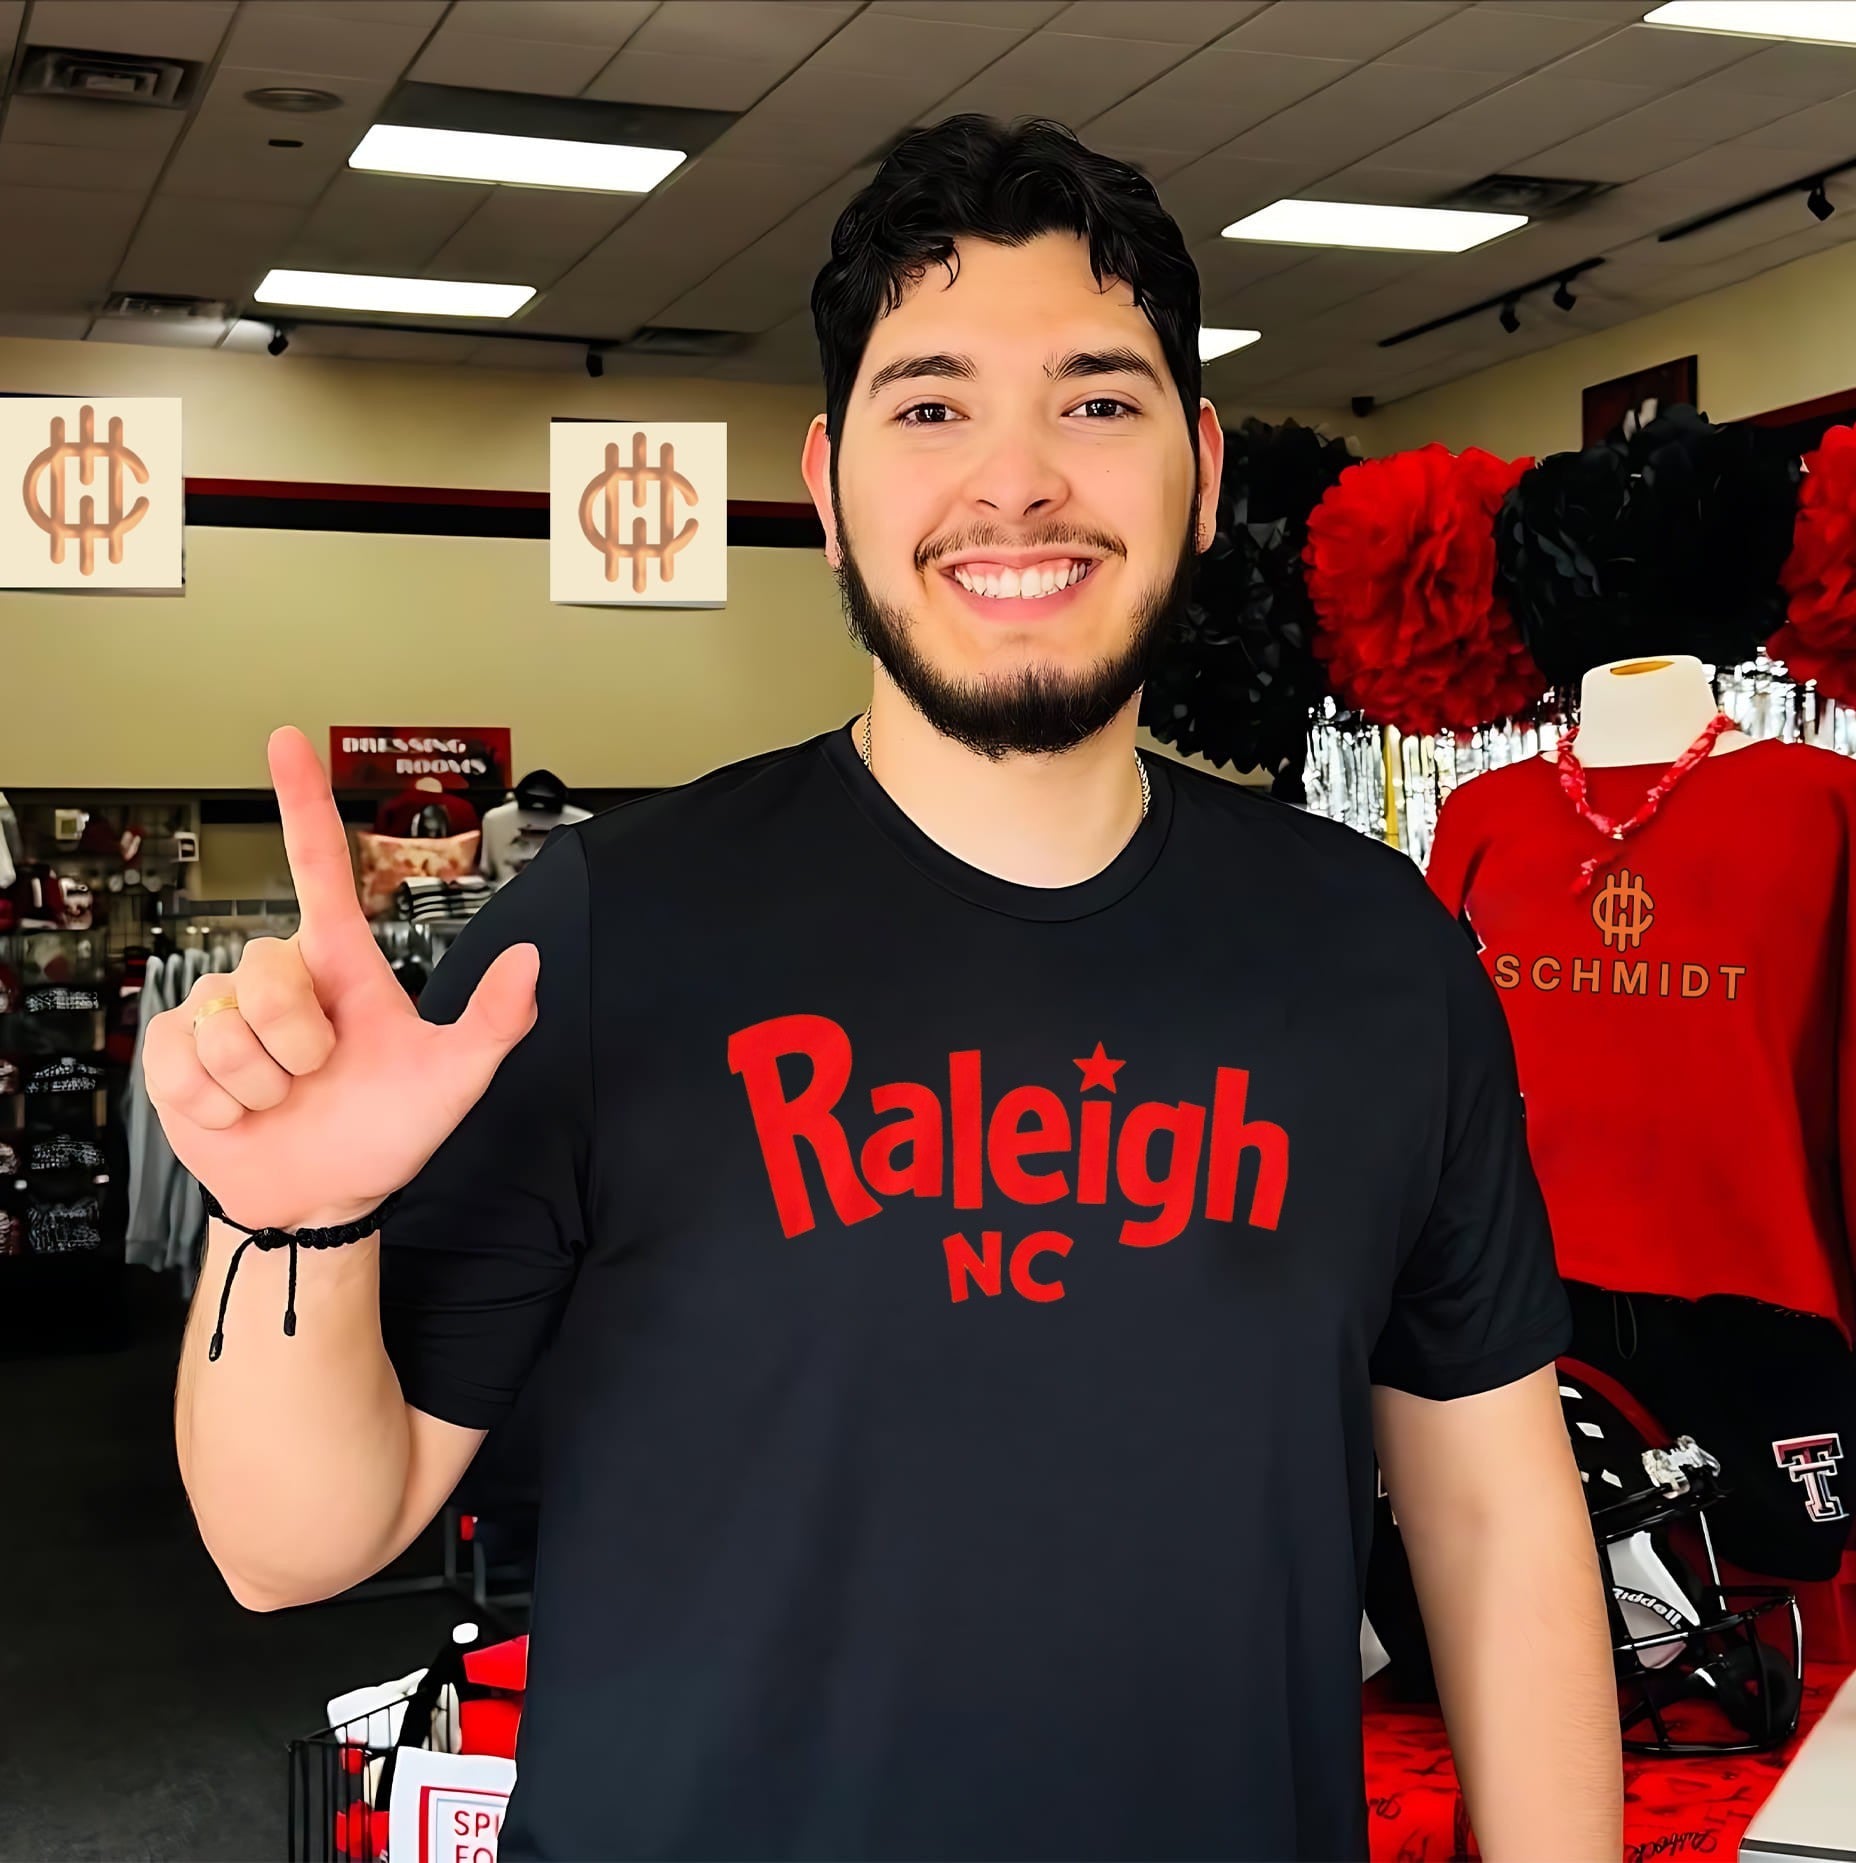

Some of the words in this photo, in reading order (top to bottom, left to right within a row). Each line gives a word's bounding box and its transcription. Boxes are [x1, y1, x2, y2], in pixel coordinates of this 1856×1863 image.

[396, 758, 487, 775] ROOMS
[1494, 954, 1747, 1000] SCHMIDT
[727, 1013, 1290, 1248] Raleigh
[942, 1230, 1074, 1303] NC
